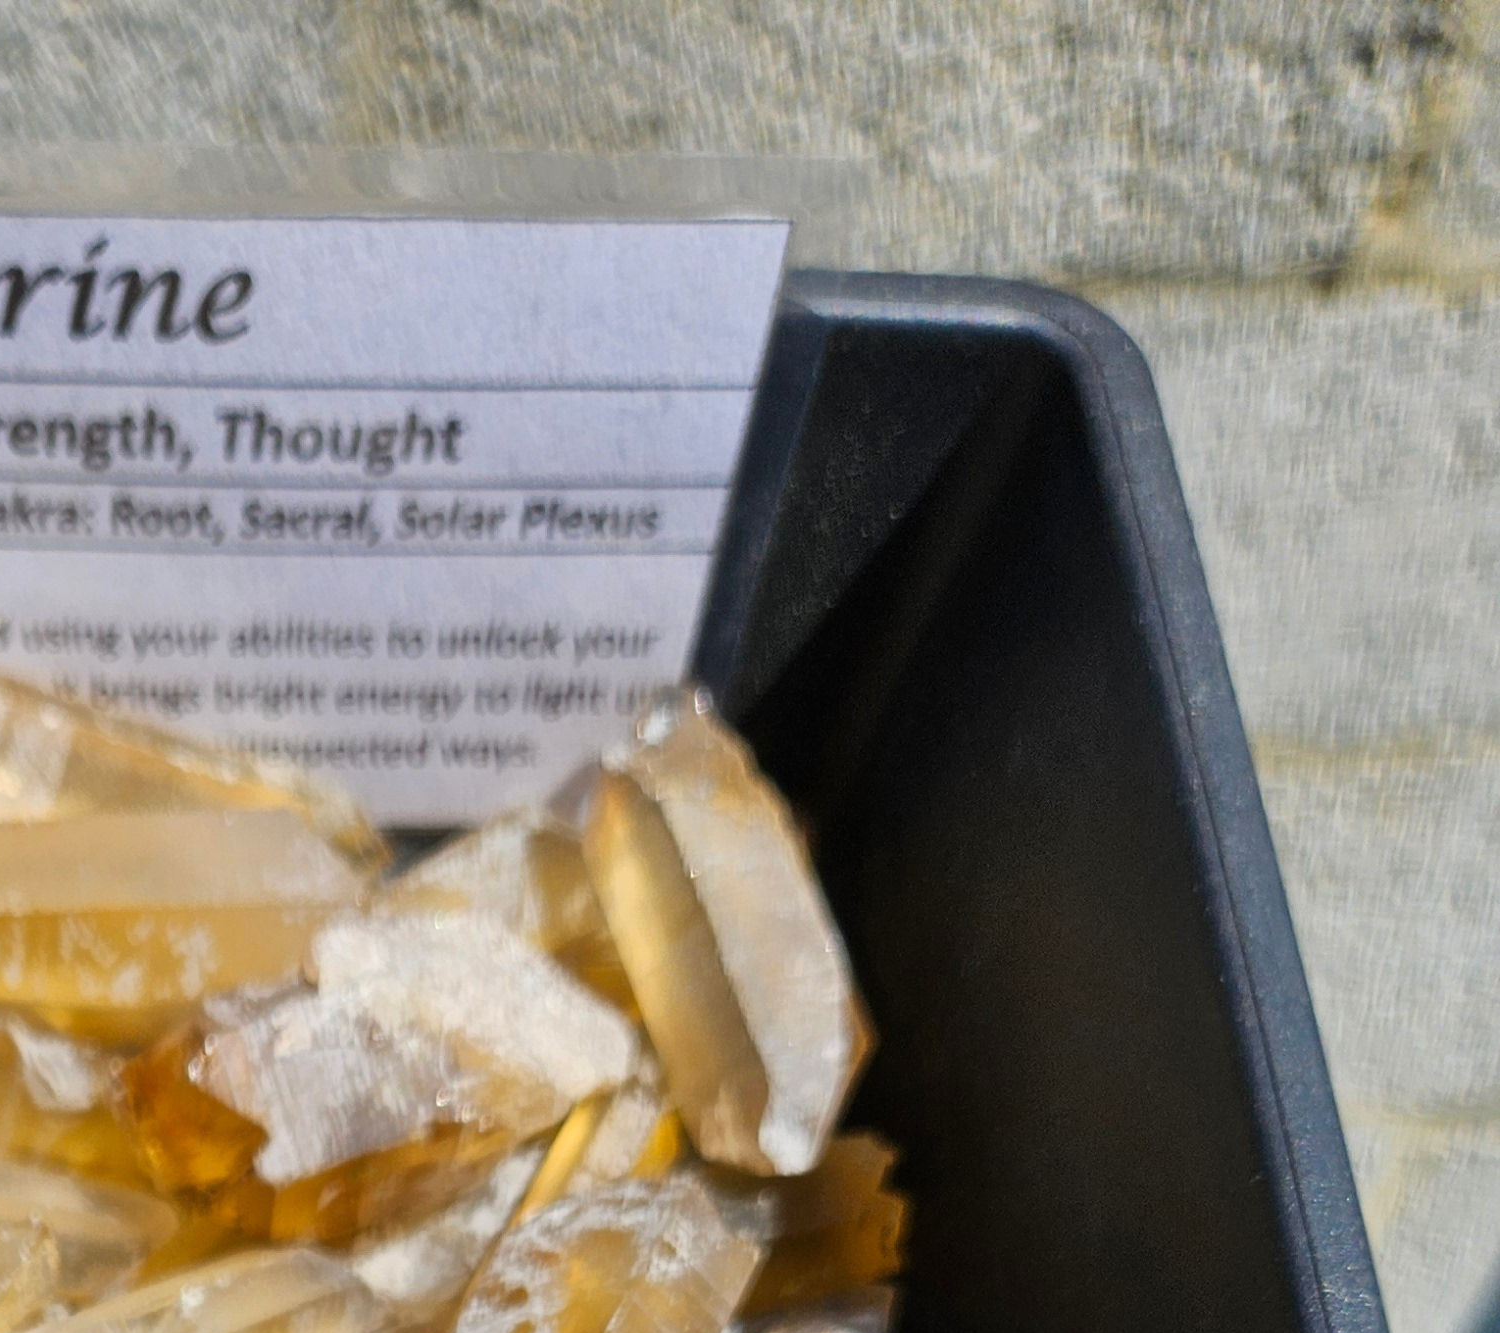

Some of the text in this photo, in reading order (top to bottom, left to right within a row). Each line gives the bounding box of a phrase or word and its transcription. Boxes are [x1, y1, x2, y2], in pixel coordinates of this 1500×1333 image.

[214, 406, 464, 477] Thought
[111, 493, 224, 546] Root,
[240, 497, 381, 547] Sacral,
[396, 500, 505, 540] Solar
[518, 501, 660, 539] Plexus
[21, 615, 121, 662] using
[130, 620, 216, 664] your
[228, 614, 374, 660] abilities
[386, 622, 426, 659] to
[437, 619, 563, 660] unlock
[573, 625, 657, 666] your
